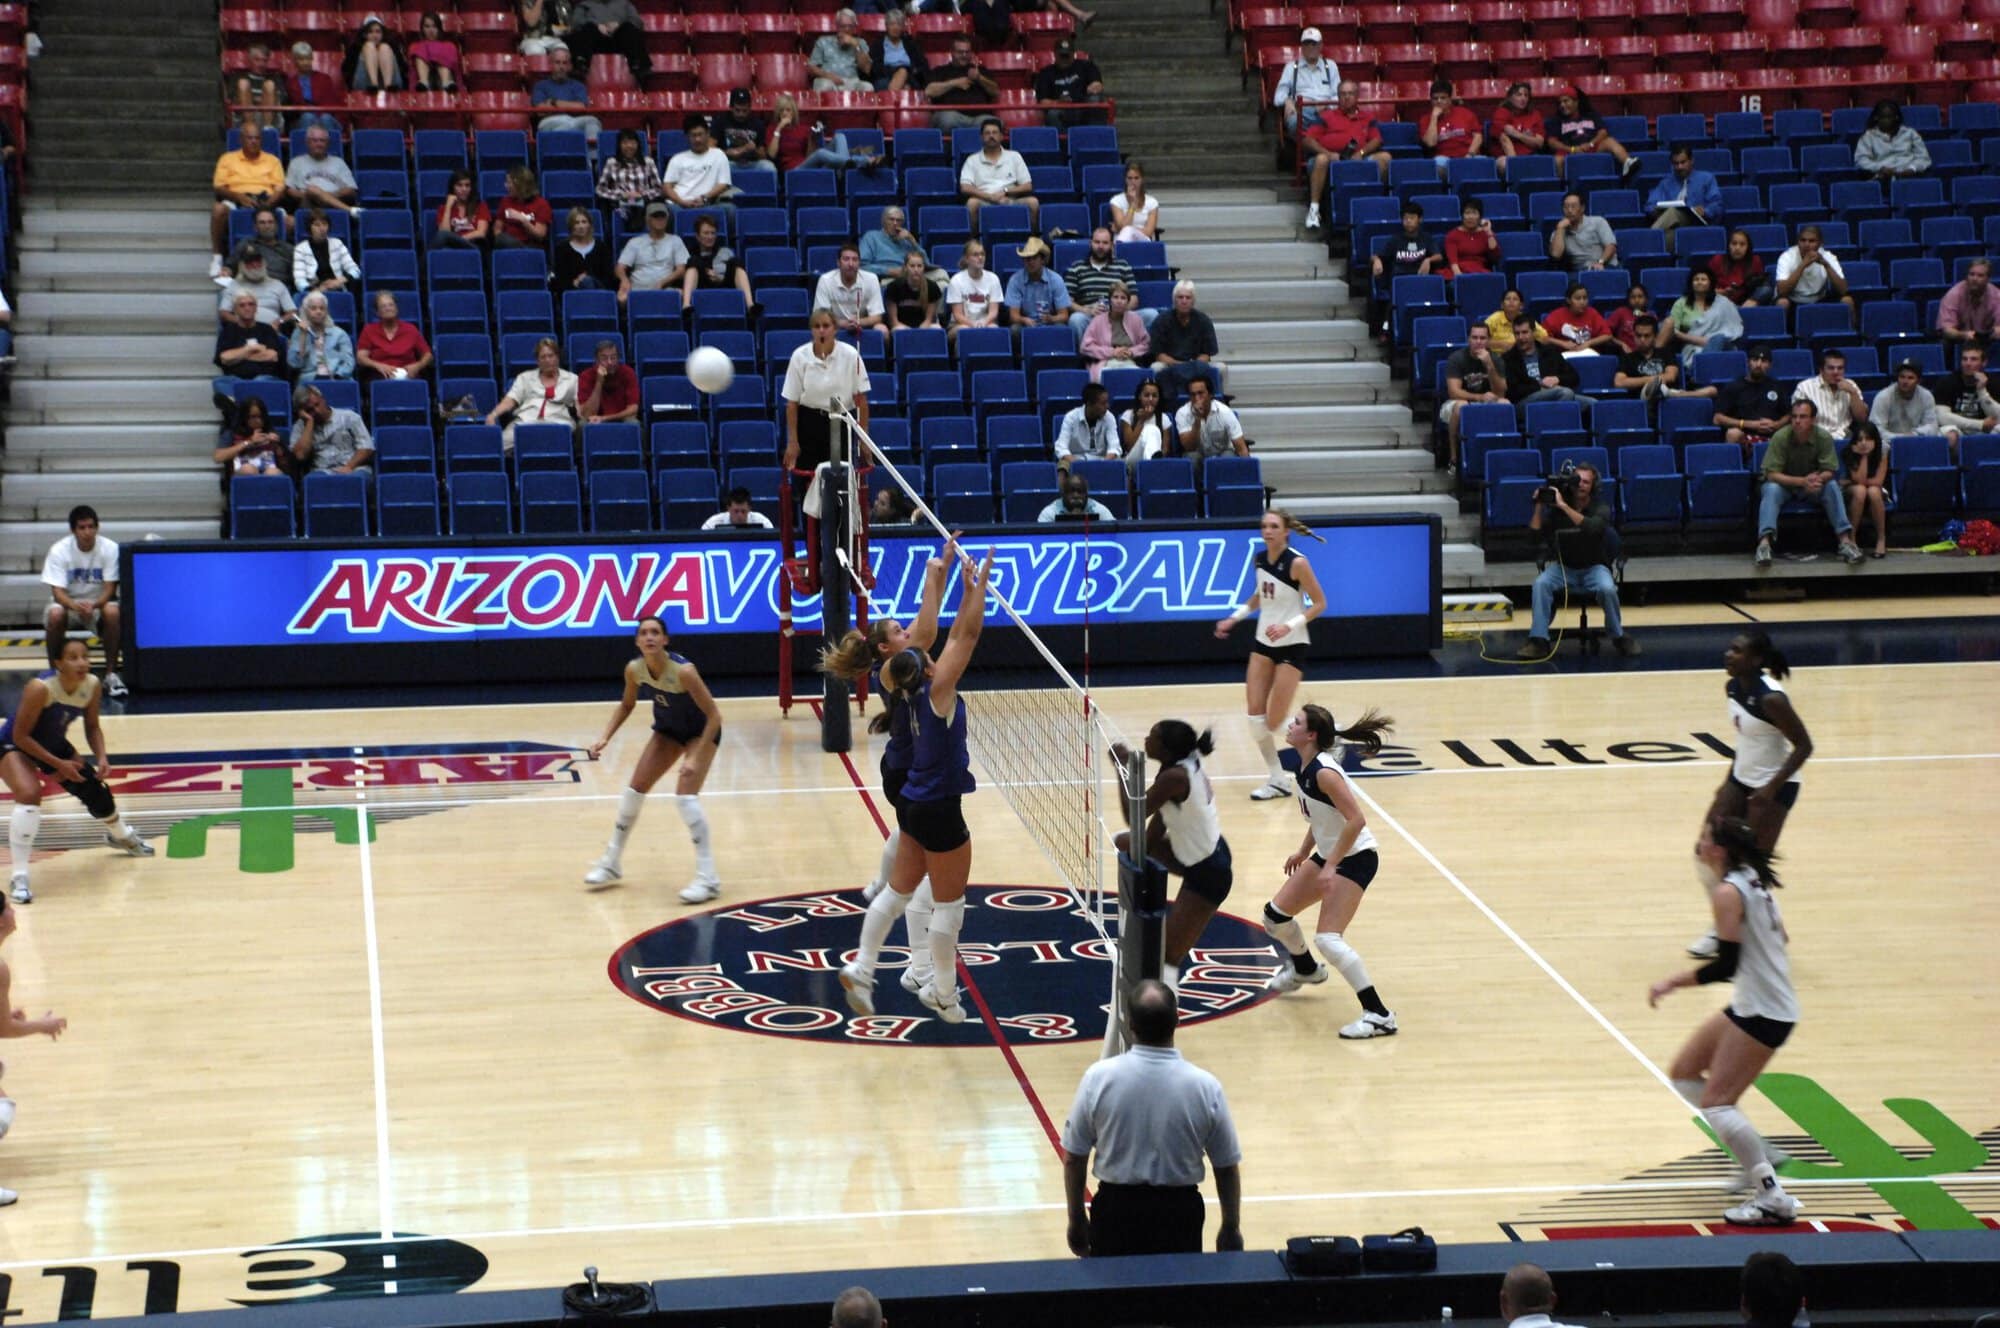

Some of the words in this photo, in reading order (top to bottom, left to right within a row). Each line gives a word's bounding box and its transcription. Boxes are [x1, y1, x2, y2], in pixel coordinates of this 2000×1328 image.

[1740, 94, 1761, 112] 16
[286, 552, 706, 634] ARIZONA
[713, 889, 1120, 933] ORT
[632, 962, 935, 1042] BOBBI
